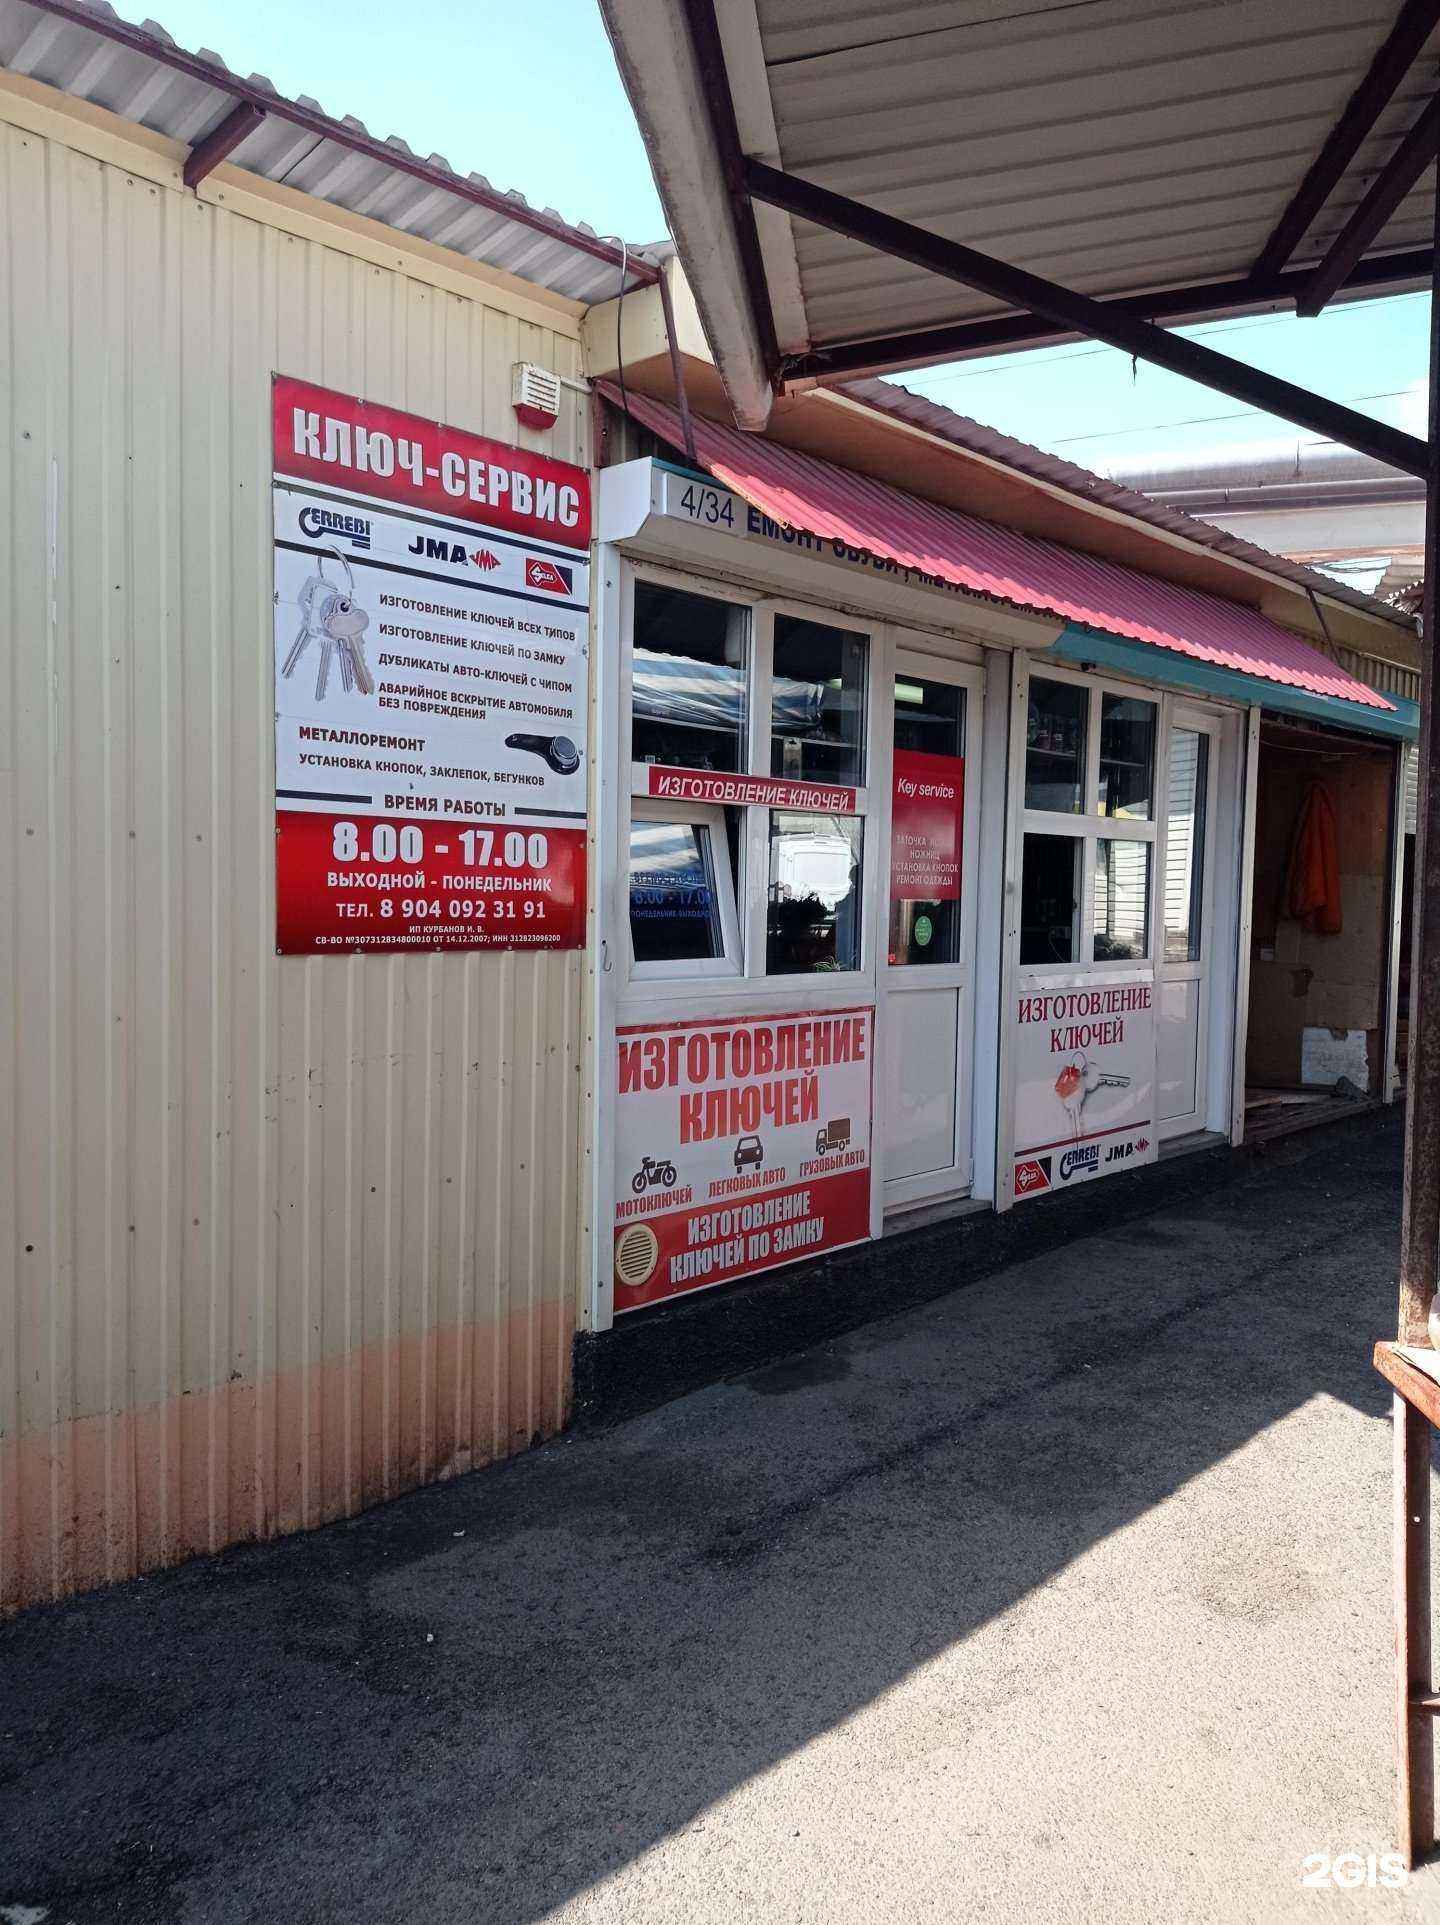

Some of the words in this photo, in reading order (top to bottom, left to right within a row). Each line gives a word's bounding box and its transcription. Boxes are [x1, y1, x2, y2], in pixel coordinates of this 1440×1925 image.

[293, 407, 580, 528] КЛЮЧ-СЕРВИС
[299, 506, 371, 539] CERREBI
[680, 484, 735, 529] 4/34
[408, 536, 468, 567] JMA
[380, 594, 468, 620] ИЗГОТОВЛЕНИЕ
[470, 608, 515, 630] КЛЮЧЕЙ
[517, 619, 541, 634] ВСЕХ
[544, 626, 576, 642] ТИПОВ
[380, 623, 468, 649] ИЗГОТОВЛЕНИЕ
[470, 637, 516, 657] КЛЮЧЕЙ
[517, 647, 532, 660] ПО
[533, 651, 565, 667] ЗАМКУ
[378, 653, 451, 674] ДУБЛИКАТЫ
[453, 664, 528, 687] АВТО-КЛЮЧЕЙ
[530, 676, 537, 687] С
[538, 678, 572, 693] ЧИПОМ
[378, 681, 448, 701] АВАРИЙНОЕ
[450, 692, 506, 710] ВСКРЫТИЕ
[508, 701, 573, 720] АВТОМОБИЛЯ
[378, 697, 400, 710] БЕЗ
[403, 699, 486, 720] ПОВРЕЖДЕНИЯ
[299, 726, 425, 752] МЕТАЛЛОРЕМОНТ
[299, 753, 372, 771] УСТАНОВКА
[375, 760, 427, 778] КНОПОК,
[430, 765, 492, 783] ЗАКЛЕПОК,
[494, 771, 545, 787] БЕГУНКОВ
[897, 777, 917, 798] Key
[919, 783, 955, 799] service
[384, 794, 438, 813] ВРЕМЯ
[443, 799, 506, 817] РАБОТЫ
[658, 775, 786, 805] ИЗГОТОВЛЕНИЕ
[789, 790, 850, 811] КЛЮЧЕЙ
[332, 821, 424, 864] 8.00
[458, 829, 549, 869] 17.00
[327, 871, 426, 890] ВЫХОДНОЙ
[442, 874, 552, 893] ПОНЕДЕЛЬНИК
[336, 903, 373, 918] ТЕЛ.
[380, 899, 394, 918] 8
[401, 899, 442, 918] 904
[449, 900, 487, 919] 092
[493, 901, 516, 919] 31
[523, 901, 546, 919] 91
[315, 936, 343, 944] СВ-ВО
[433, 935, 443, 943] ОТ
[409, 925, 421, 933] ИП
[423, 925, 465, 934] КУРБАНОВ
[1018, 987, 1152, 1024] ИЗГОТОВЛЕНИЕ
[1050, 1015, 1124, 1053] КЛЮЧЕЙ
[618, 1016, 865, 1095] ИЗГОТОВЛЕНИЕ
[680, 1068, 819, 1145] КЛЮЧЕЙ
[800, 1153, 844, 1178] ГРУЗОВЫХ
[844, 1150, 865, 1169] АВТО
[1105, 1142, 1133, 1162] JMA
[616, 1183, 692, 1219] МОТОКЛЮЧЕЙ
[708, 1171, 761, 1199] ЛЕГКОВЫХ
[762, 1167, 786, 1188] АВТО
[688, 1190, 811, 1246] ИЗГОТОВЛЕНИЕ
[670, 1233, 744, 1284] КЛЮЧЕЙ
[748, 1235, 769, 1261] ПО
[773, 1216, 824, 1255] ЗАМКУ
